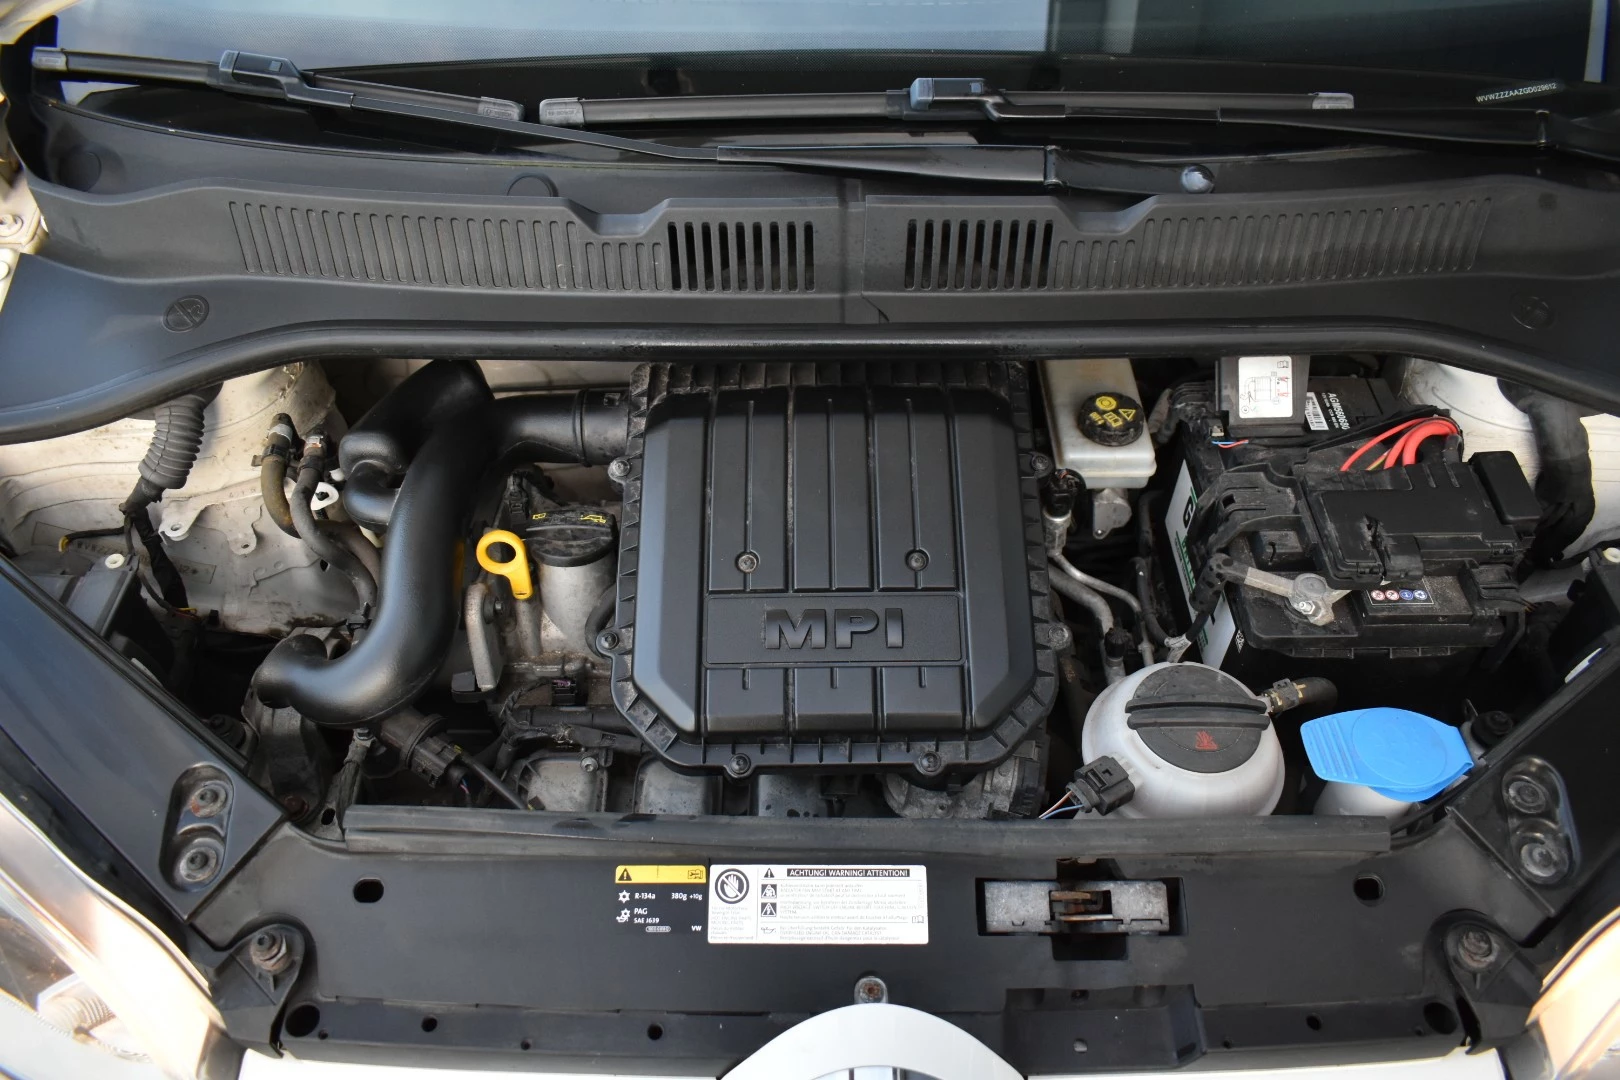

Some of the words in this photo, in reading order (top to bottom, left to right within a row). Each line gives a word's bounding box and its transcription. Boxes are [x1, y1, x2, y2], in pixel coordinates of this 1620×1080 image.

[763, 608, 904, 649] MPI
[789, 869, 827, 877] ACHTUNG!
[828, 869, 866, 877] WARNING!
[866, 869, 908, 877] ATTENTION!
[634, 892, 656, 900] R-134a
[671, 892, 688, 901] 380g
[633, 907, 648, 915] PAG
